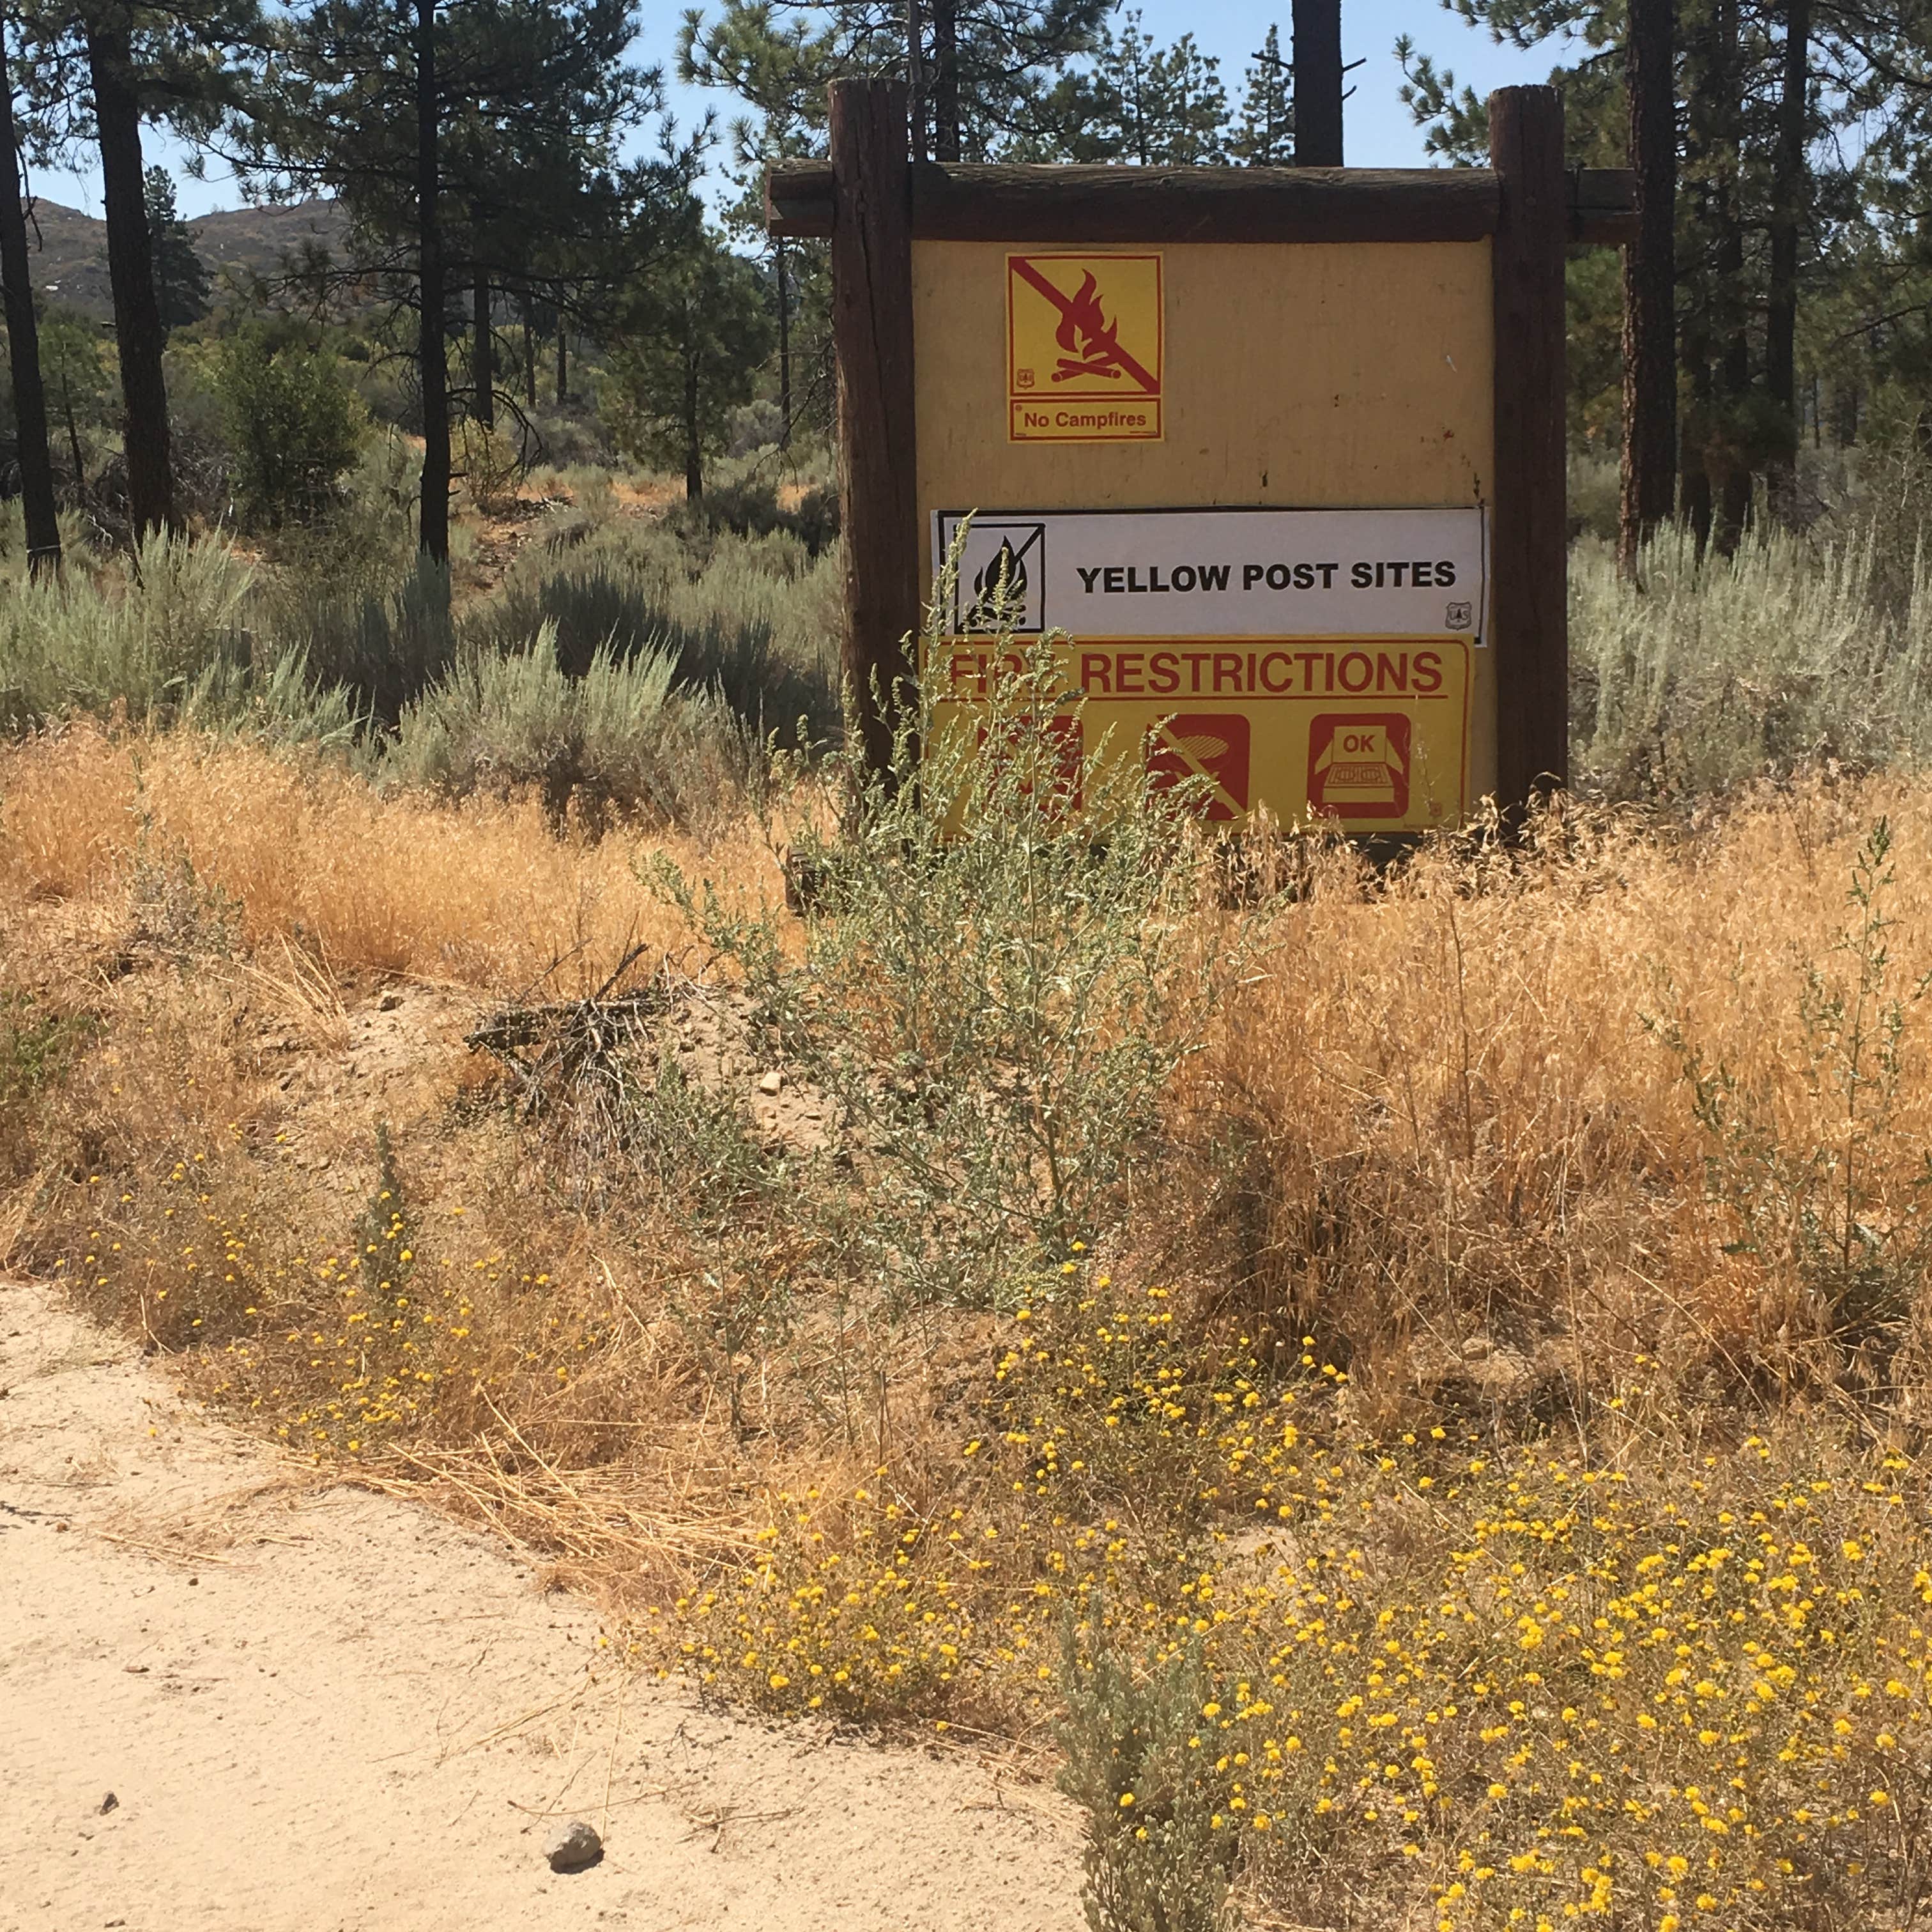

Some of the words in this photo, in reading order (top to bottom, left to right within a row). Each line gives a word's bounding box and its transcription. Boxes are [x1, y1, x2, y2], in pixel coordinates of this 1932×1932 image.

[1024, 412, 1049, 427] No
[1055, 411, 1146, 430] Campfires
[1076, 565, 1231, 593] YELLOW
[1243, 563, 1338, 591] POST
[1350, 560, 1457, 588] SITES
[1081, 651, 1443, 693] RESTRICTIONS
[1343, 735, 1376, 753] OK
